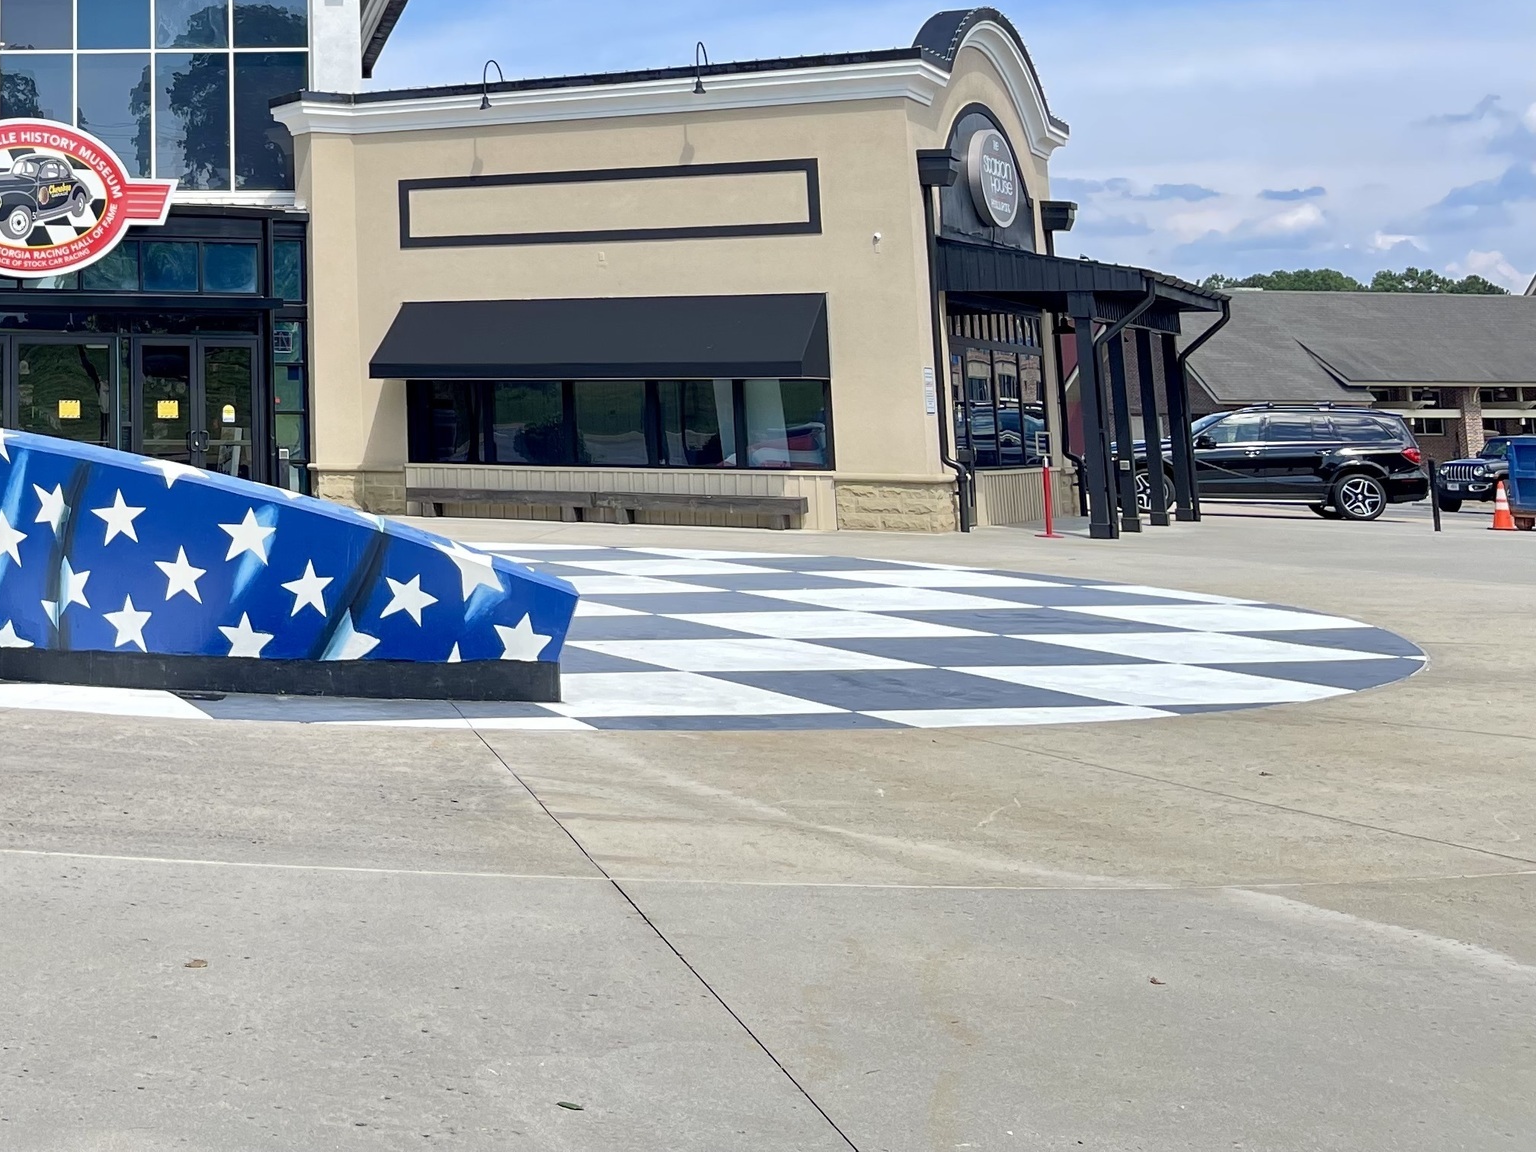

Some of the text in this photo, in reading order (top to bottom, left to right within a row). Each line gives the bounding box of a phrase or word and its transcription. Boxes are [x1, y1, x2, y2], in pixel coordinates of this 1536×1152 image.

[20, 131, 78, 151] HISTORY
[78, 146, 123, 199] MUSEUM
[11, 259, 23, 267] OF
[24, 259, 47, 267] STOCK
[48, 257, 63, 266] CAR
[64, 248, 91, 263] RACING
[33, 246, 70, 259] RACING
[70, 237, 94, 250] HALL
[92, 226, 104, 239] OF
[104, 203, 118, 228] FAME
